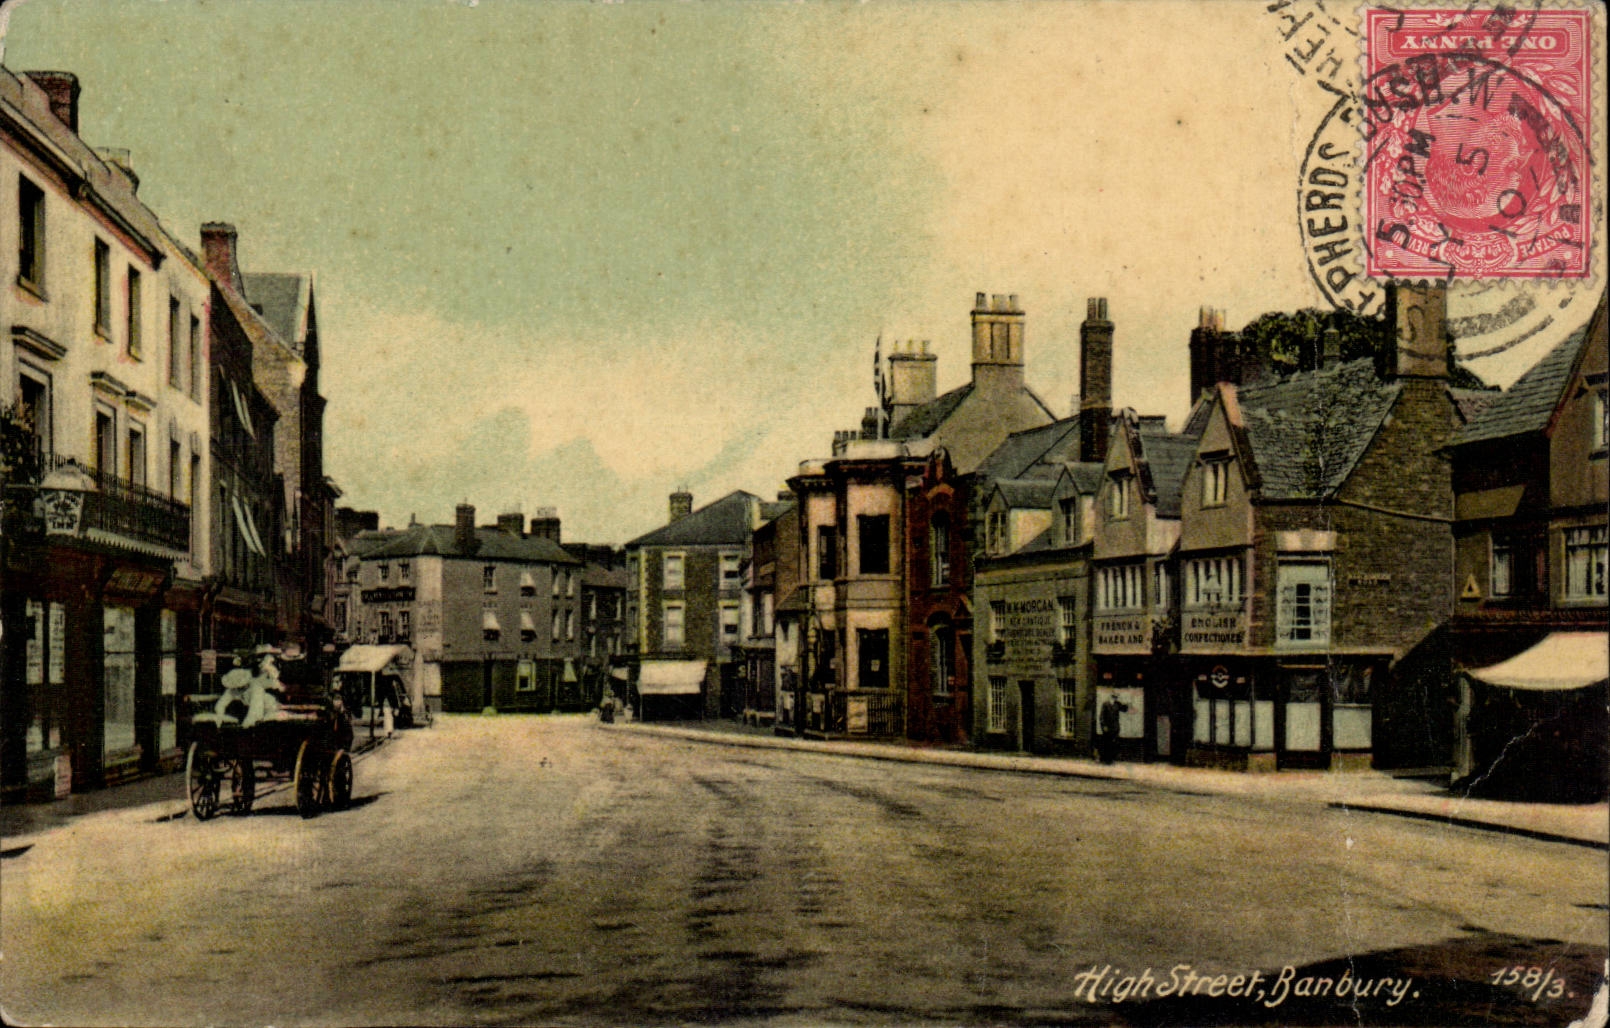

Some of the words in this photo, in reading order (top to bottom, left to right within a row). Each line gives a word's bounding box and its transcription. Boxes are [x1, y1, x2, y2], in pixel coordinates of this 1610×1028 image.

[1400, 35, 1491, 50] PENNY
[1501, 35, 1557, 50] ONE
[1101, 621, 1132, 631] FRENCH
[1191, 617, 1236, 629] ENGLISH
[1099, 634, 1125, 645] BAKER
[1127, 634, 1144, 644] AND
